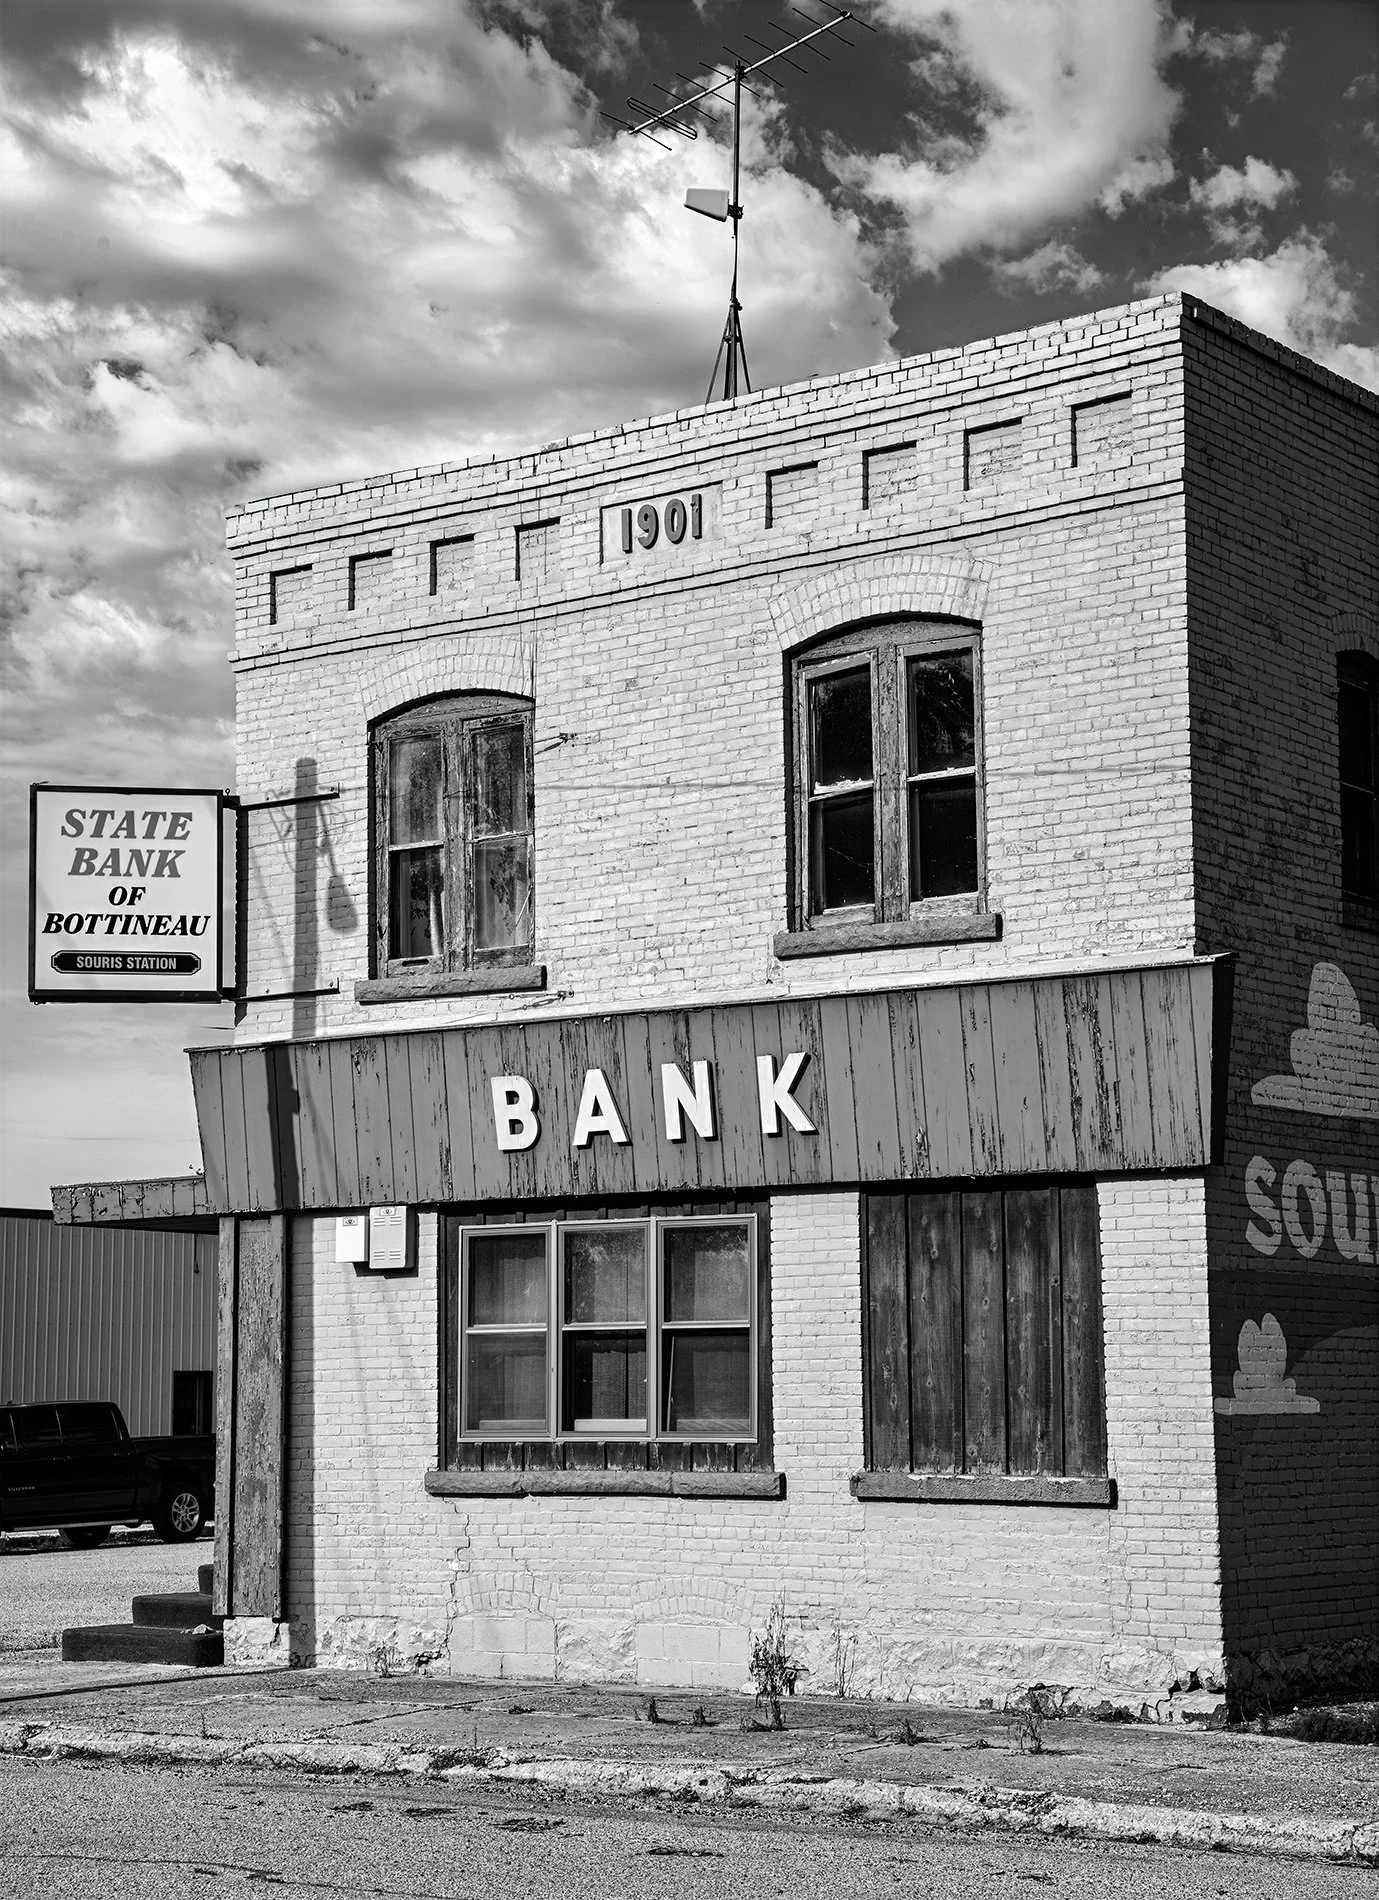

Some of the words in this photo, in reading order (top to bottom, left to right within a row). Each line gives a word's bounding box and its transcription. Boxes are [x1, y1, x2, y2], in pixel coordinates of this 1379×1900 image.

[621, 493, 702, 553] 1901
[61, 808, 193, 841] STATE
[68, 847, 186, 878] BANK
[108, 885, 146, 906] OF
[42, 912, 211, 936] BOTTINEAU
[76, 955, 123, 969] SOURIS
[126, 956, 177, 970] STATION
[491, 1052, 818, 1152] BANK
[1245, 1155, 1379, 1264] SOU
